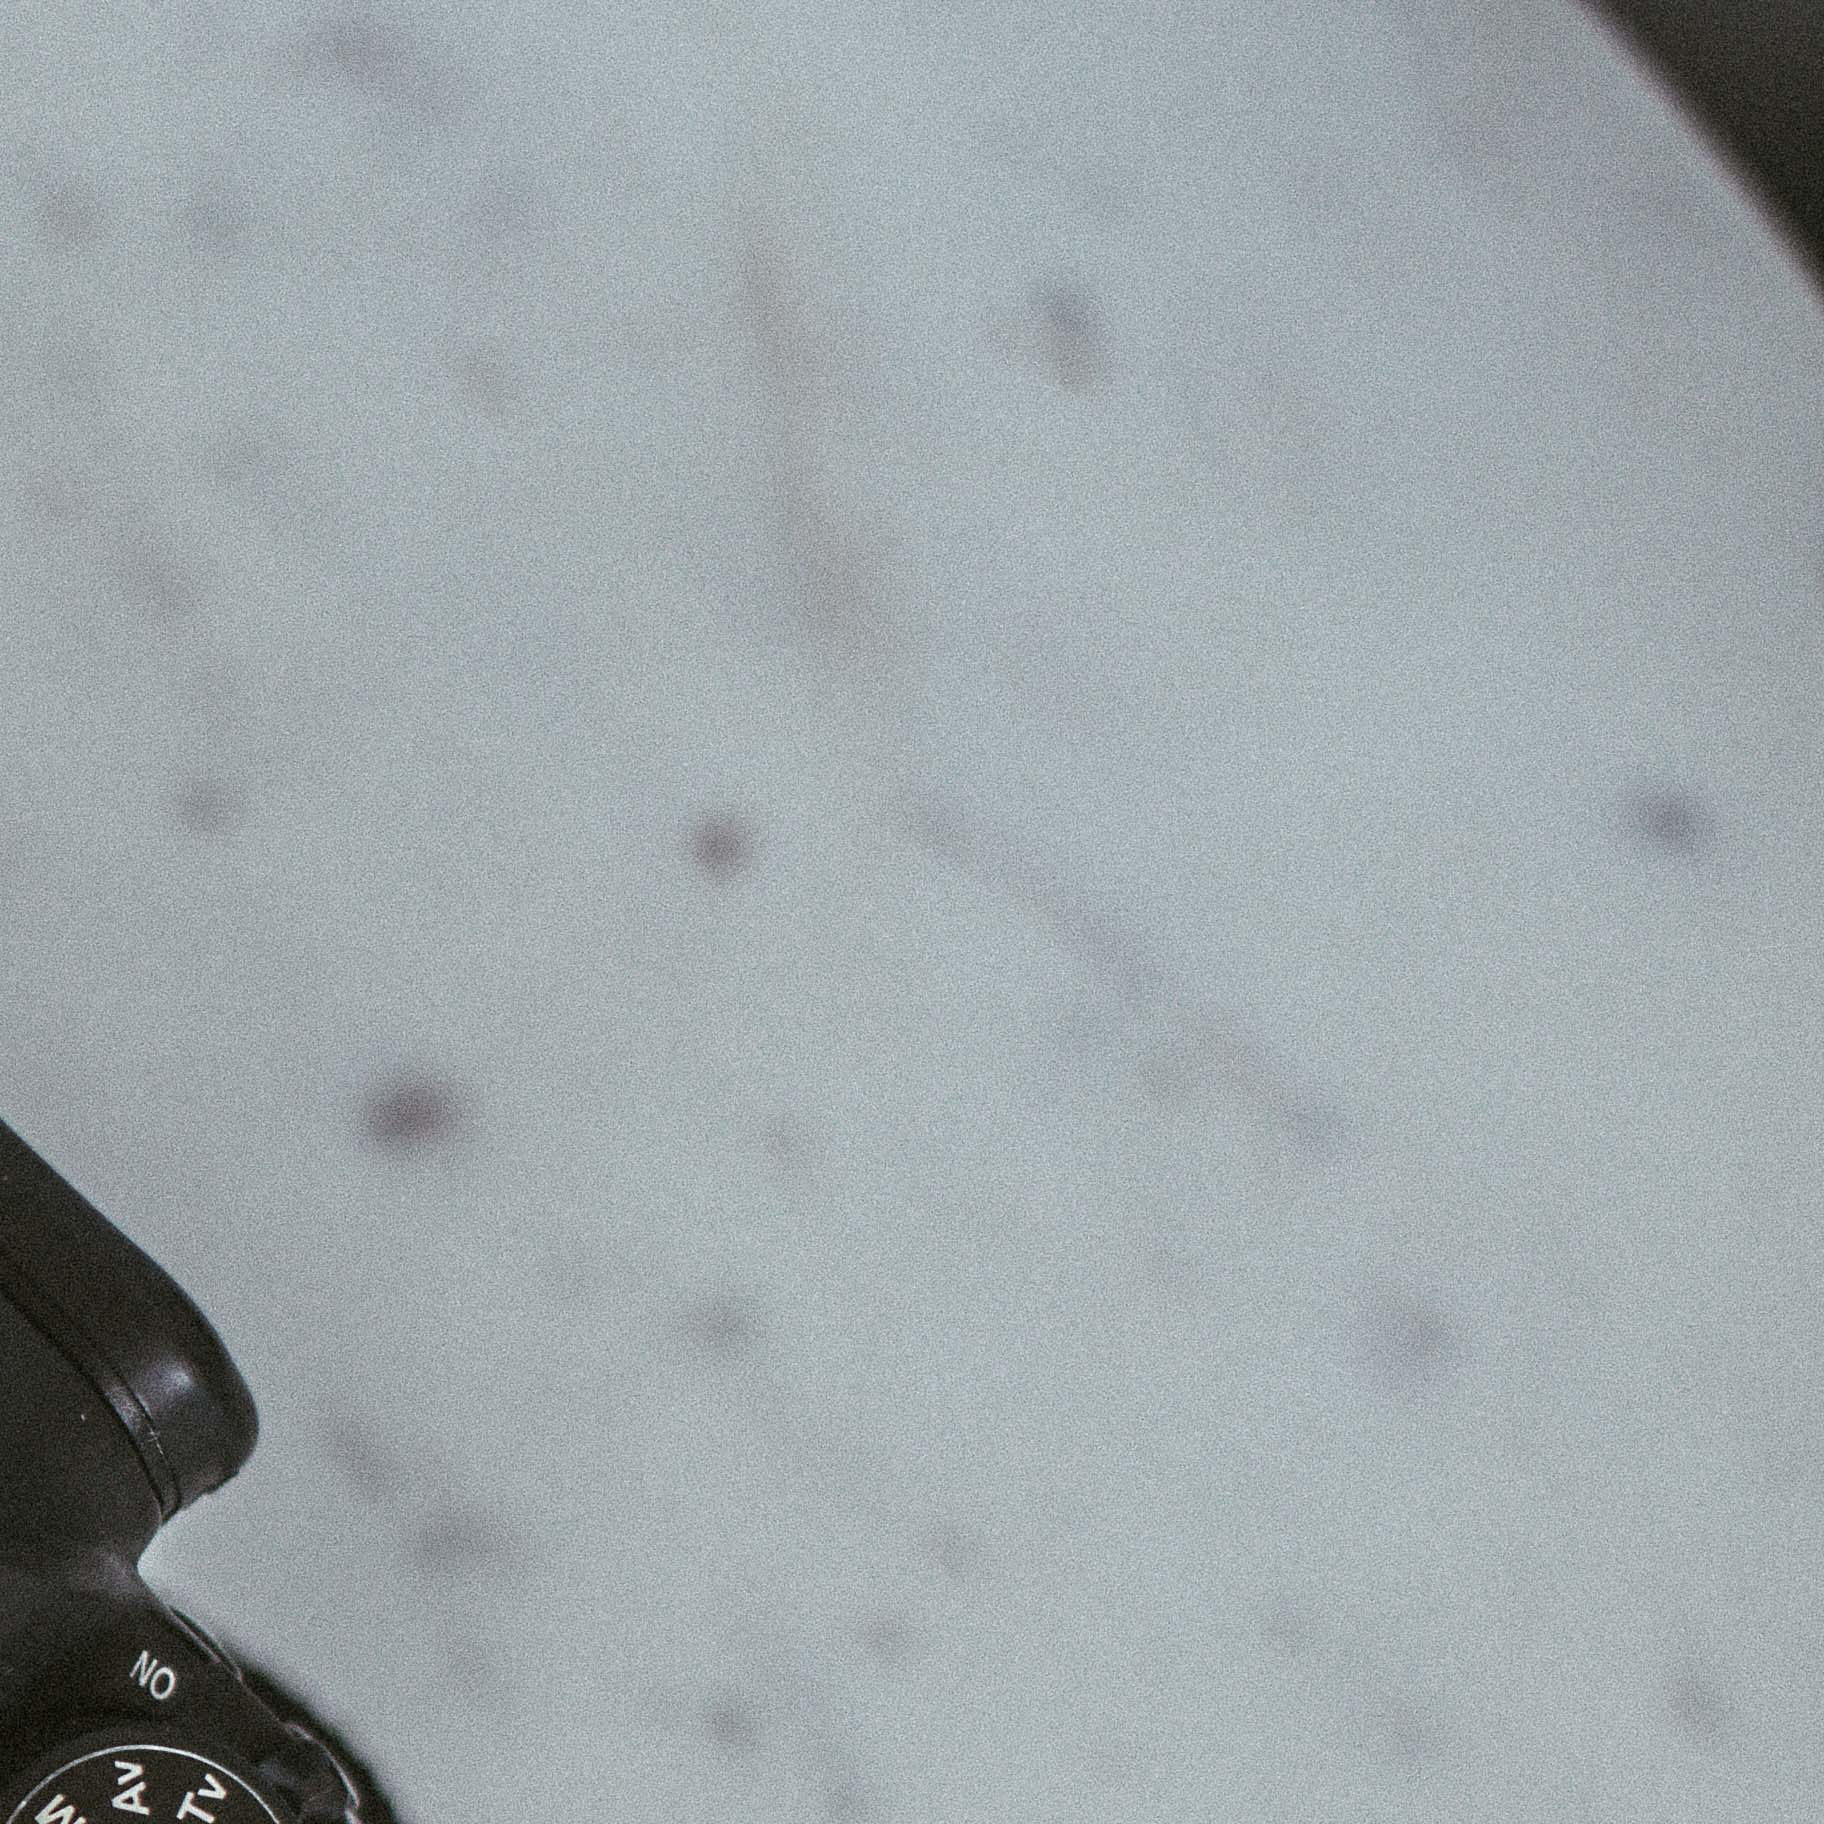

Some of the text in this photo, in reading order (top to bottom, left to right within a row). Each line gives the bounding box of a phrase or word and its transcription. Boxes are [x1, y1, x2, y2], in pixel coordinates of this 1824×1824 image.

[131, 1650, 178, 1700] ON
[112, 1761, 151, 1816] Av
[177, 1774, 228, 1824] Tv
